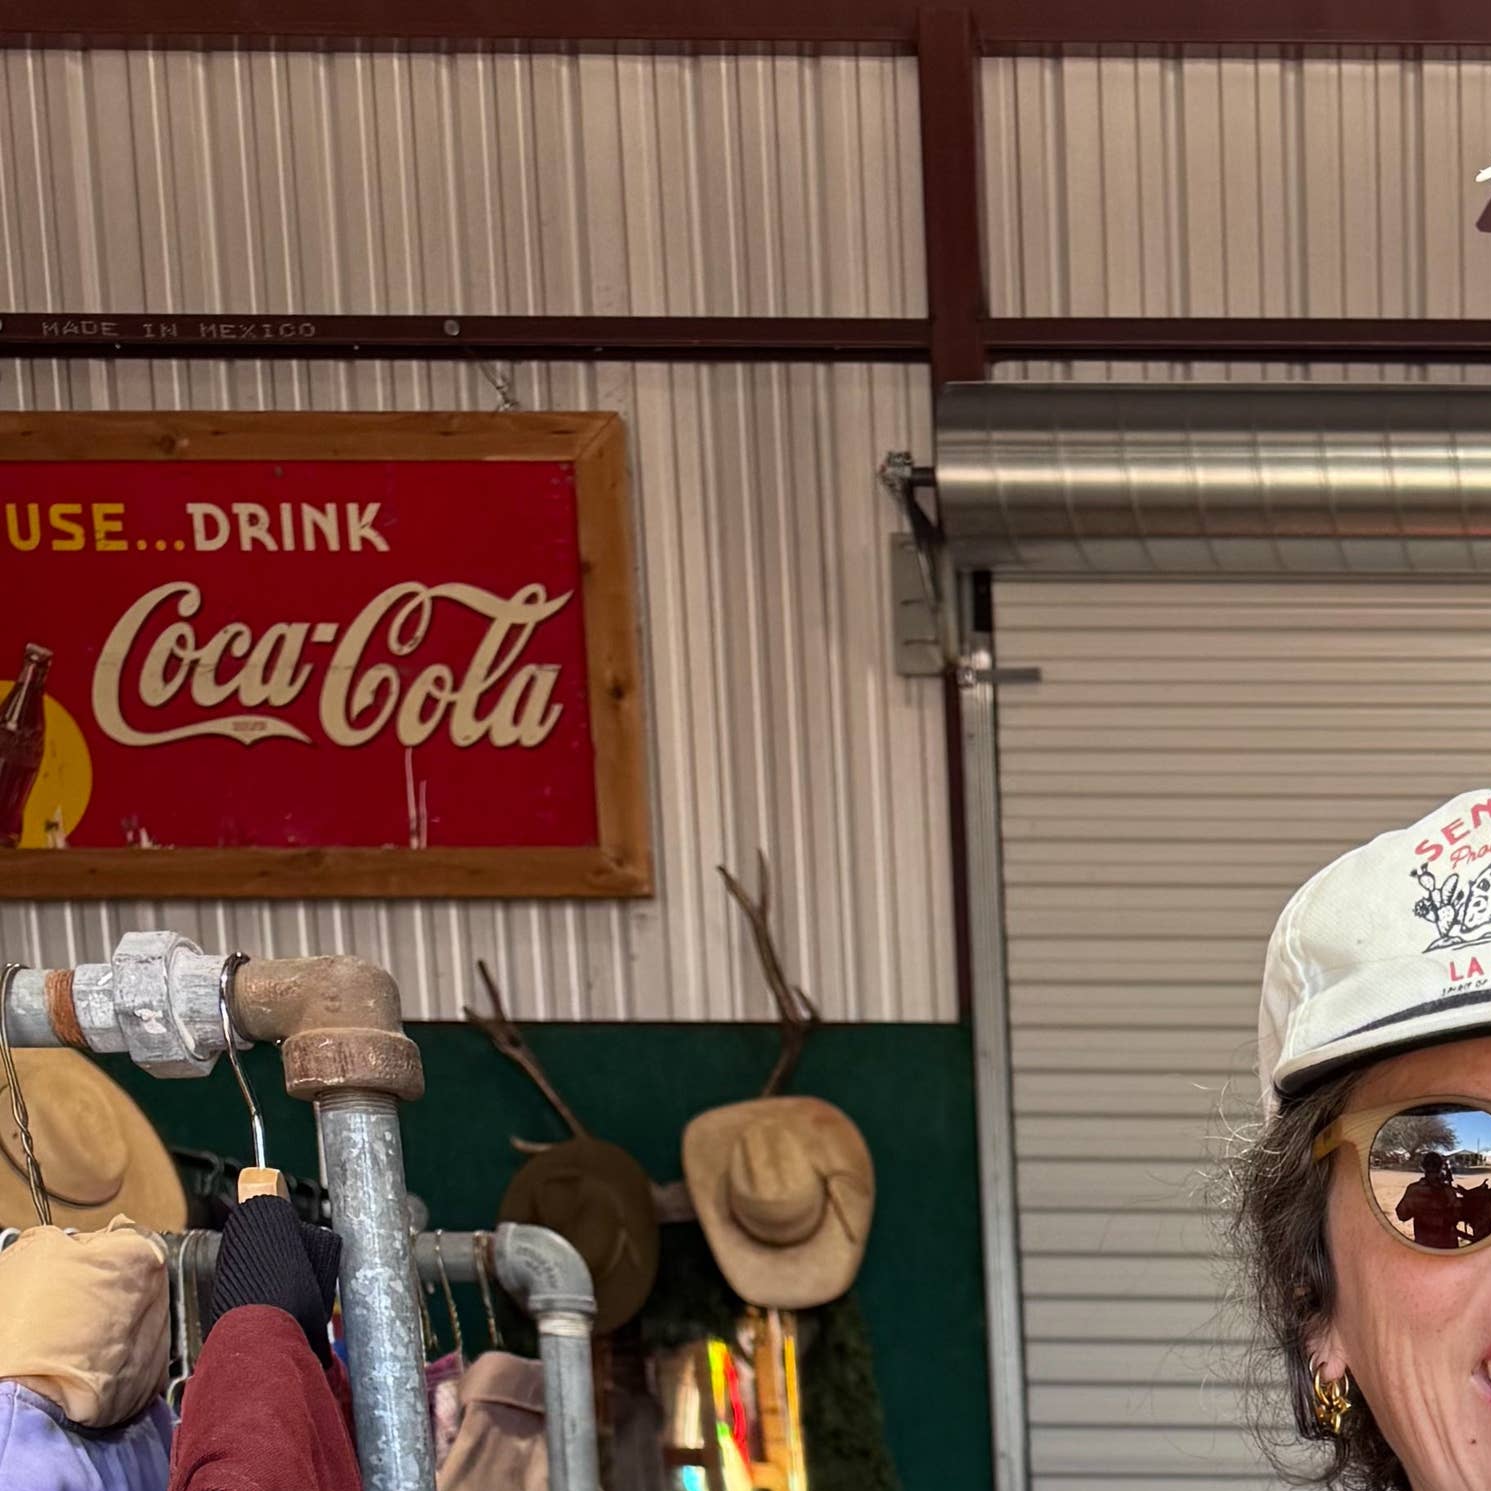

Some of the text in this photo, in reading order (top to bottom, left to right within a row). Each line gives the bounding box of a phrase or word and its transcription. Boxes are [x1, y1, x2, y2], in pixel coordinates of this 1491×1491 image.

[42, 320, 317, 339] MADE IN MEXICO
[92, 580, 574, 748] Coca-Cola
[1449, 956, 1484, 982] LA
